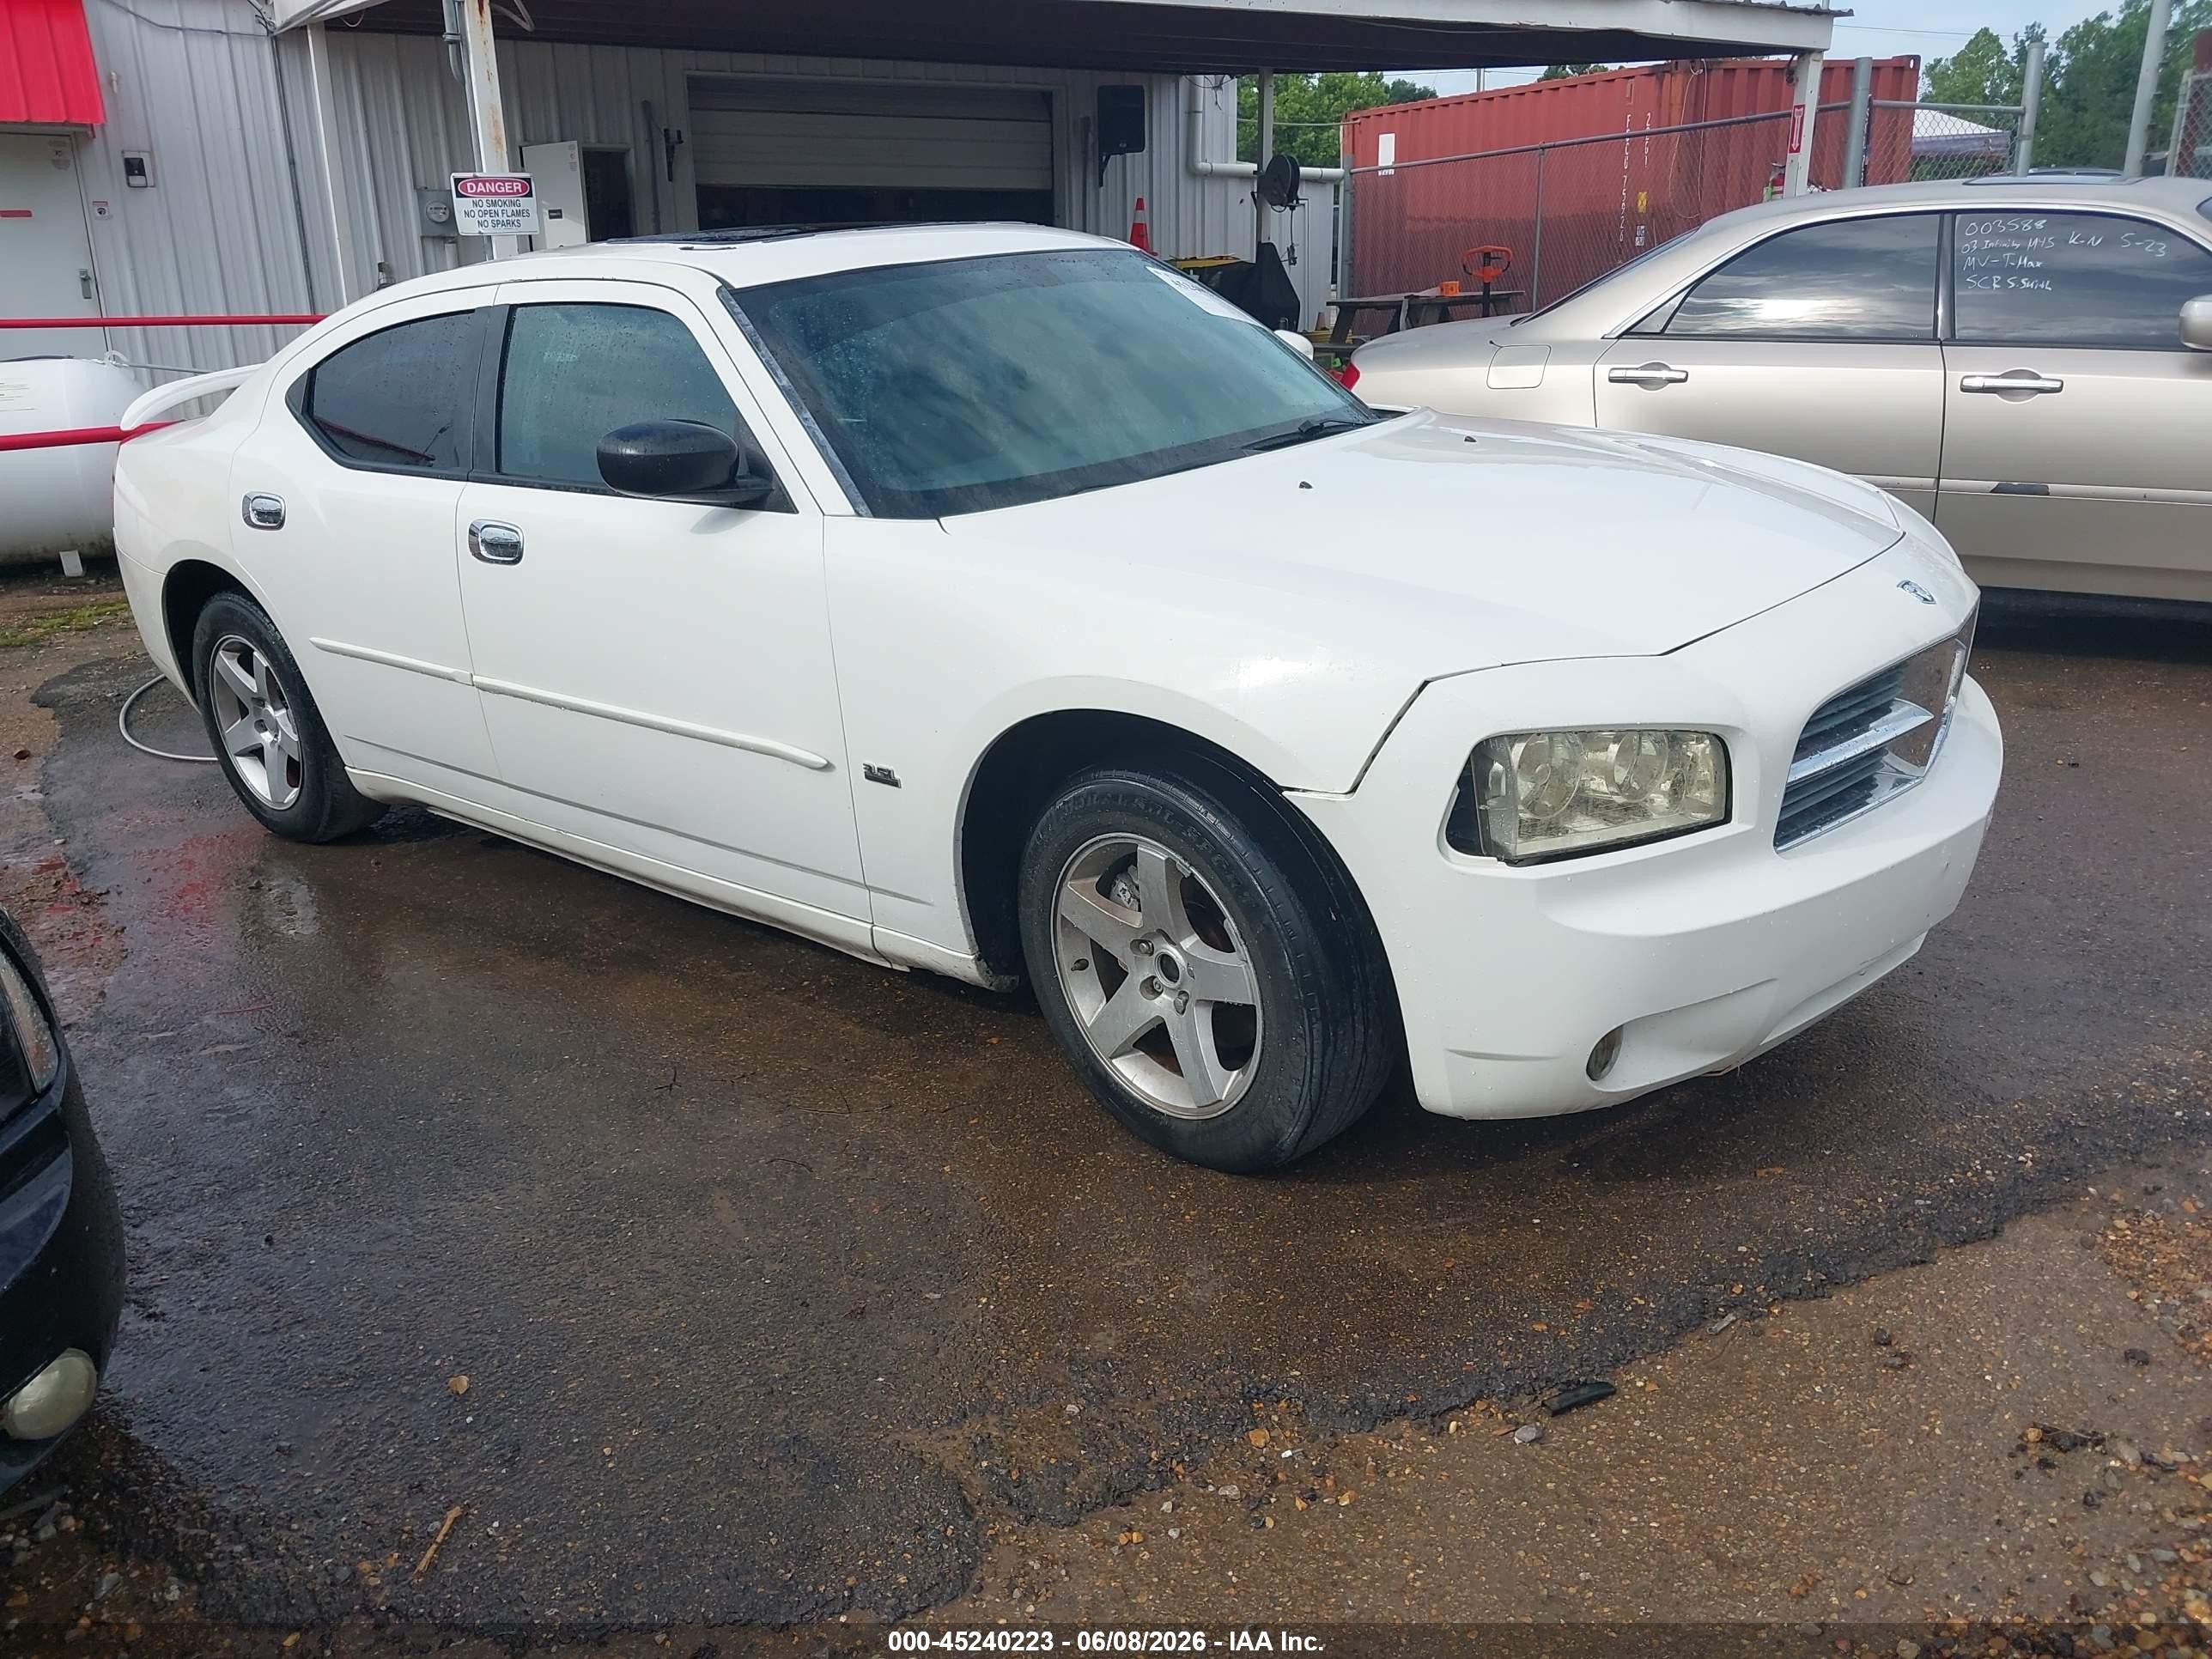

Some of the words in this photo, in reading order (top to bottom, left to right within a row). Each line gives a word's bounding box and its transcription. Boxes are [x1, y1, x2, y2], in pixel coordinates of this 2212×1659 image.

[466, 182, 523, 193] DANGER
[472, 199, 484, 208] NO
[486, 198, 521, 208] SMOKING
[464, 210, 476, 218] NO
[477, 210, 500, 218] OPEN
[501, 209, 531, 218] FLAMES
[477, 219, 489, 228] NO
[490, 219, 522, 228] SPARKS
[1965, 217, 2048, 236] 003588
[1960, 240, 1978, 254] 03
[2027, 236, 2056, 252] M45
[1966, 274, 2002, 291] SCR
